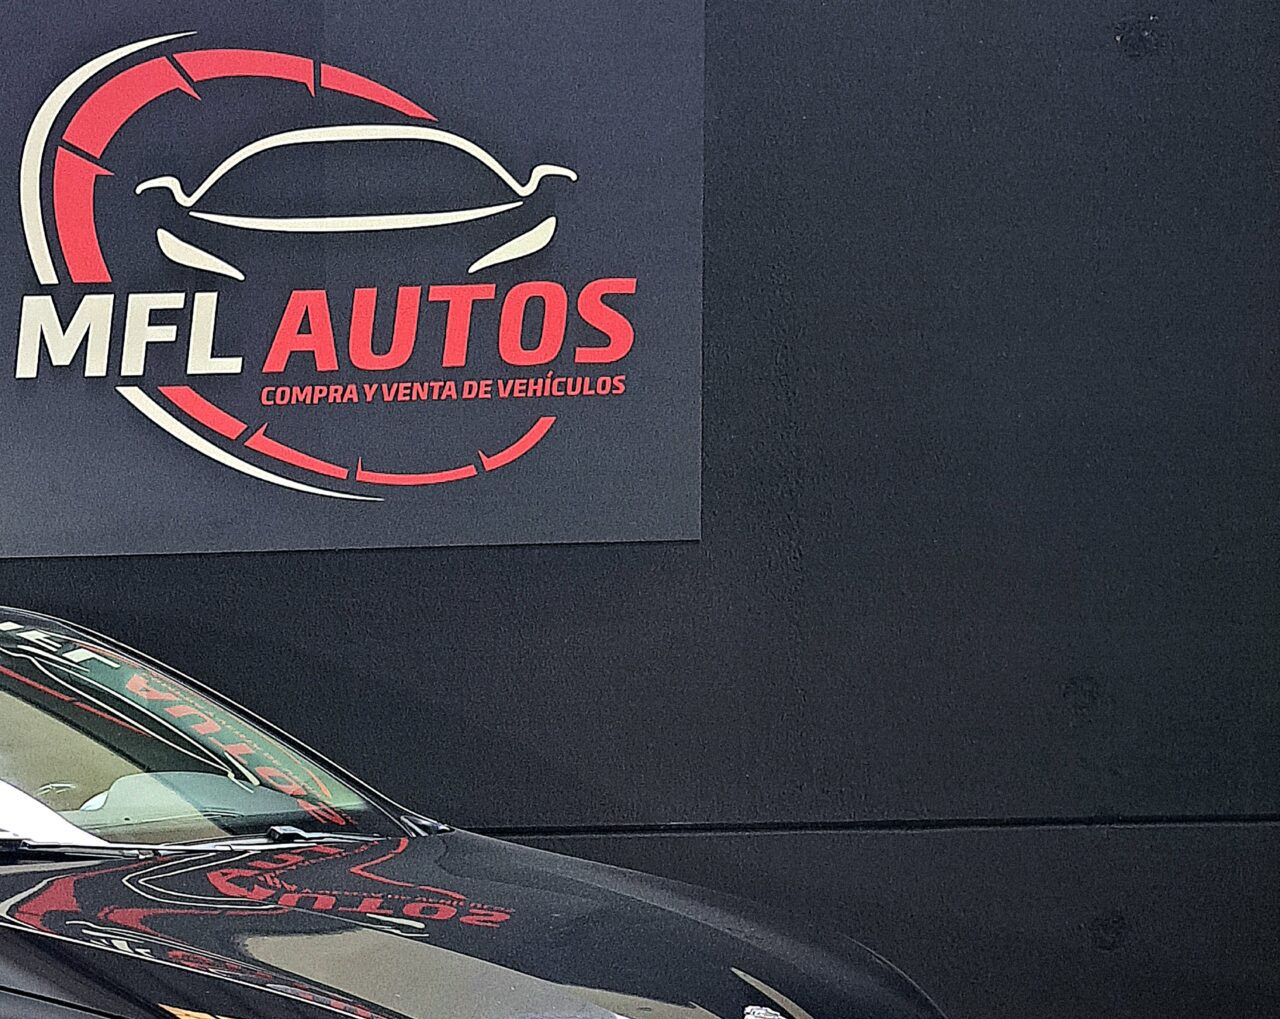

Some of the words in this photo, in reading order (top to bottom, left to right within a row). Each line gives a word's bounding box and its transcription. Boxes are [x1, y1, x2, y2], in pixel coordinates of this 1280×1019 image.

[15, 291, 244, 379] MFL
[262, 277, 638, 374] AUTOS
[261, 384, 359, 405] COMPRA
[360, 383, 379, 403] Y
[381, 381, 458, 402] VENTA
[461, 380, 493, 400] DE
[497, 372, 625, 399] VEHÍCULOS
